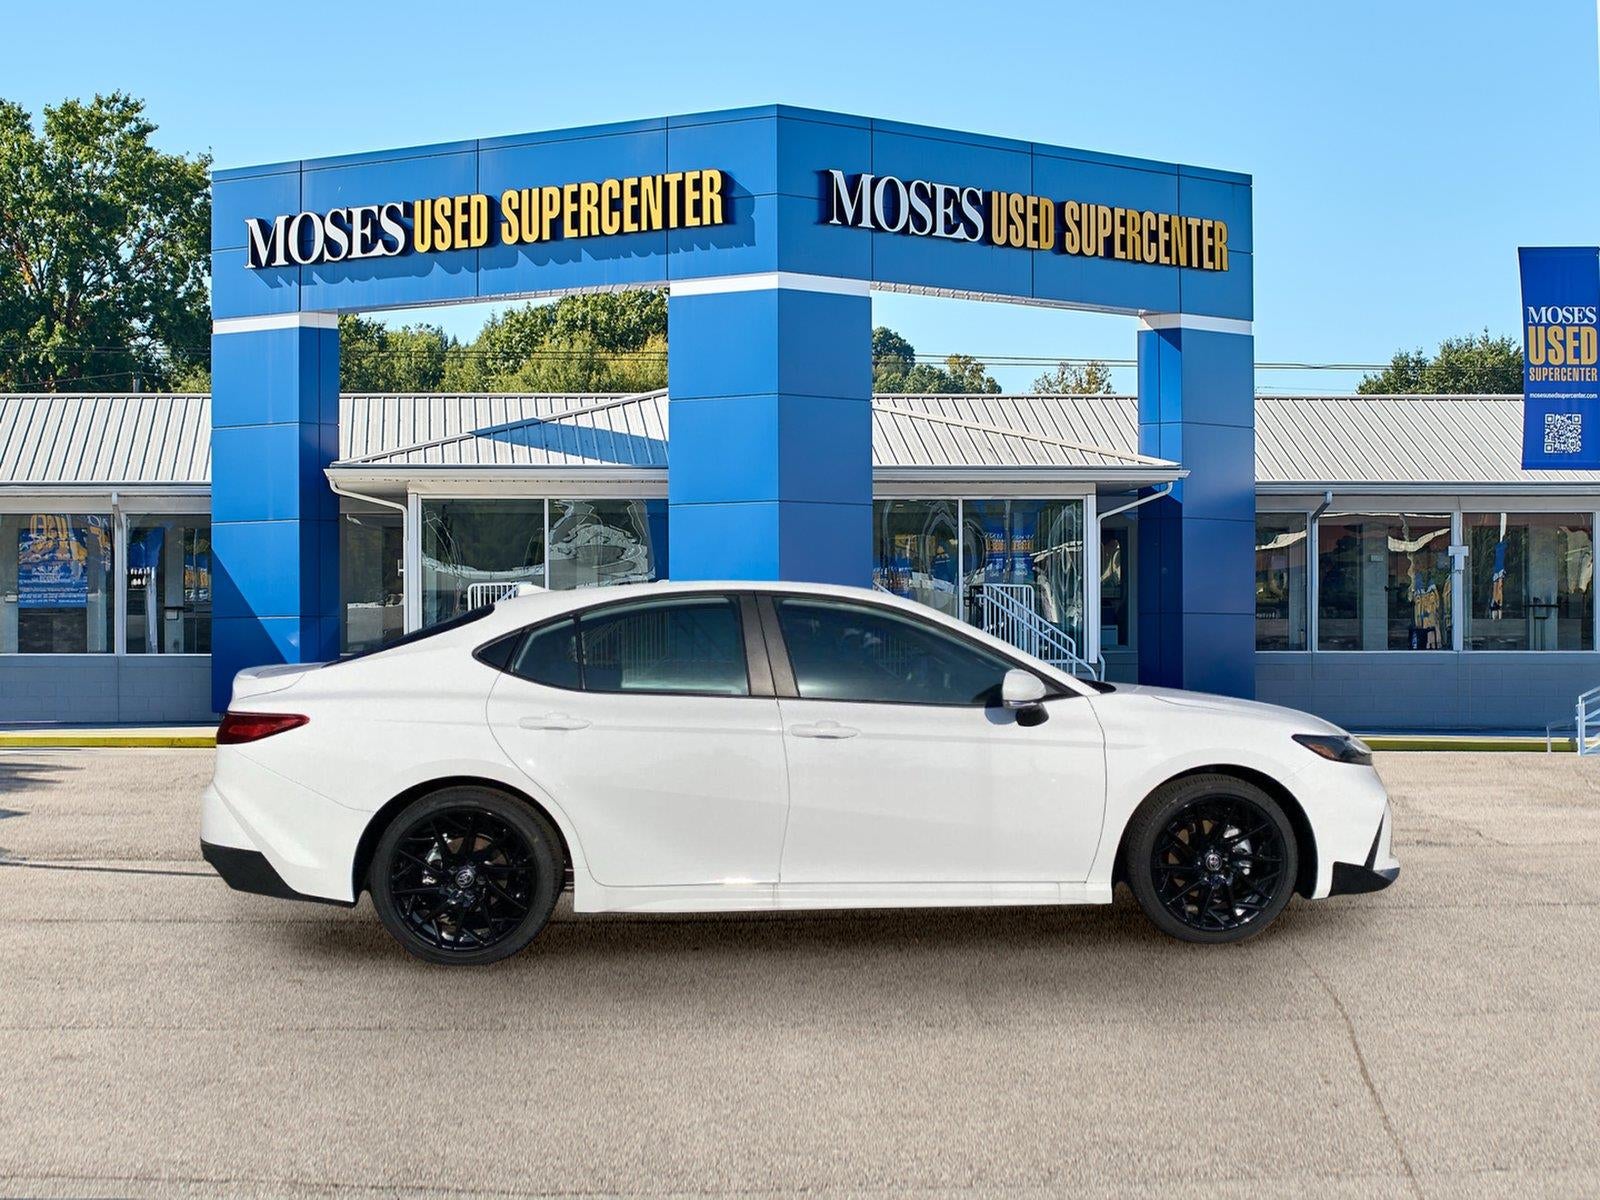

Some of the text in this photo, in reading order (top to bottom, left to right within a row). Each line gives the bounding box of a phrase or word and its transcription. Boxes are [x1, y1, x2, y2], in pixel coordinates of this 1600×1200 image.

[244, 169, 724, 269] MOSES USED SUPERCENTER
[828, 169, 1229, 271] MOSES USED SUPERCENTER
[1528, 306, 1597, 324] MOSES
[1528, 326, 1597, 365] USED
[1529, 367, 1597, 382] SUPERCENTER
